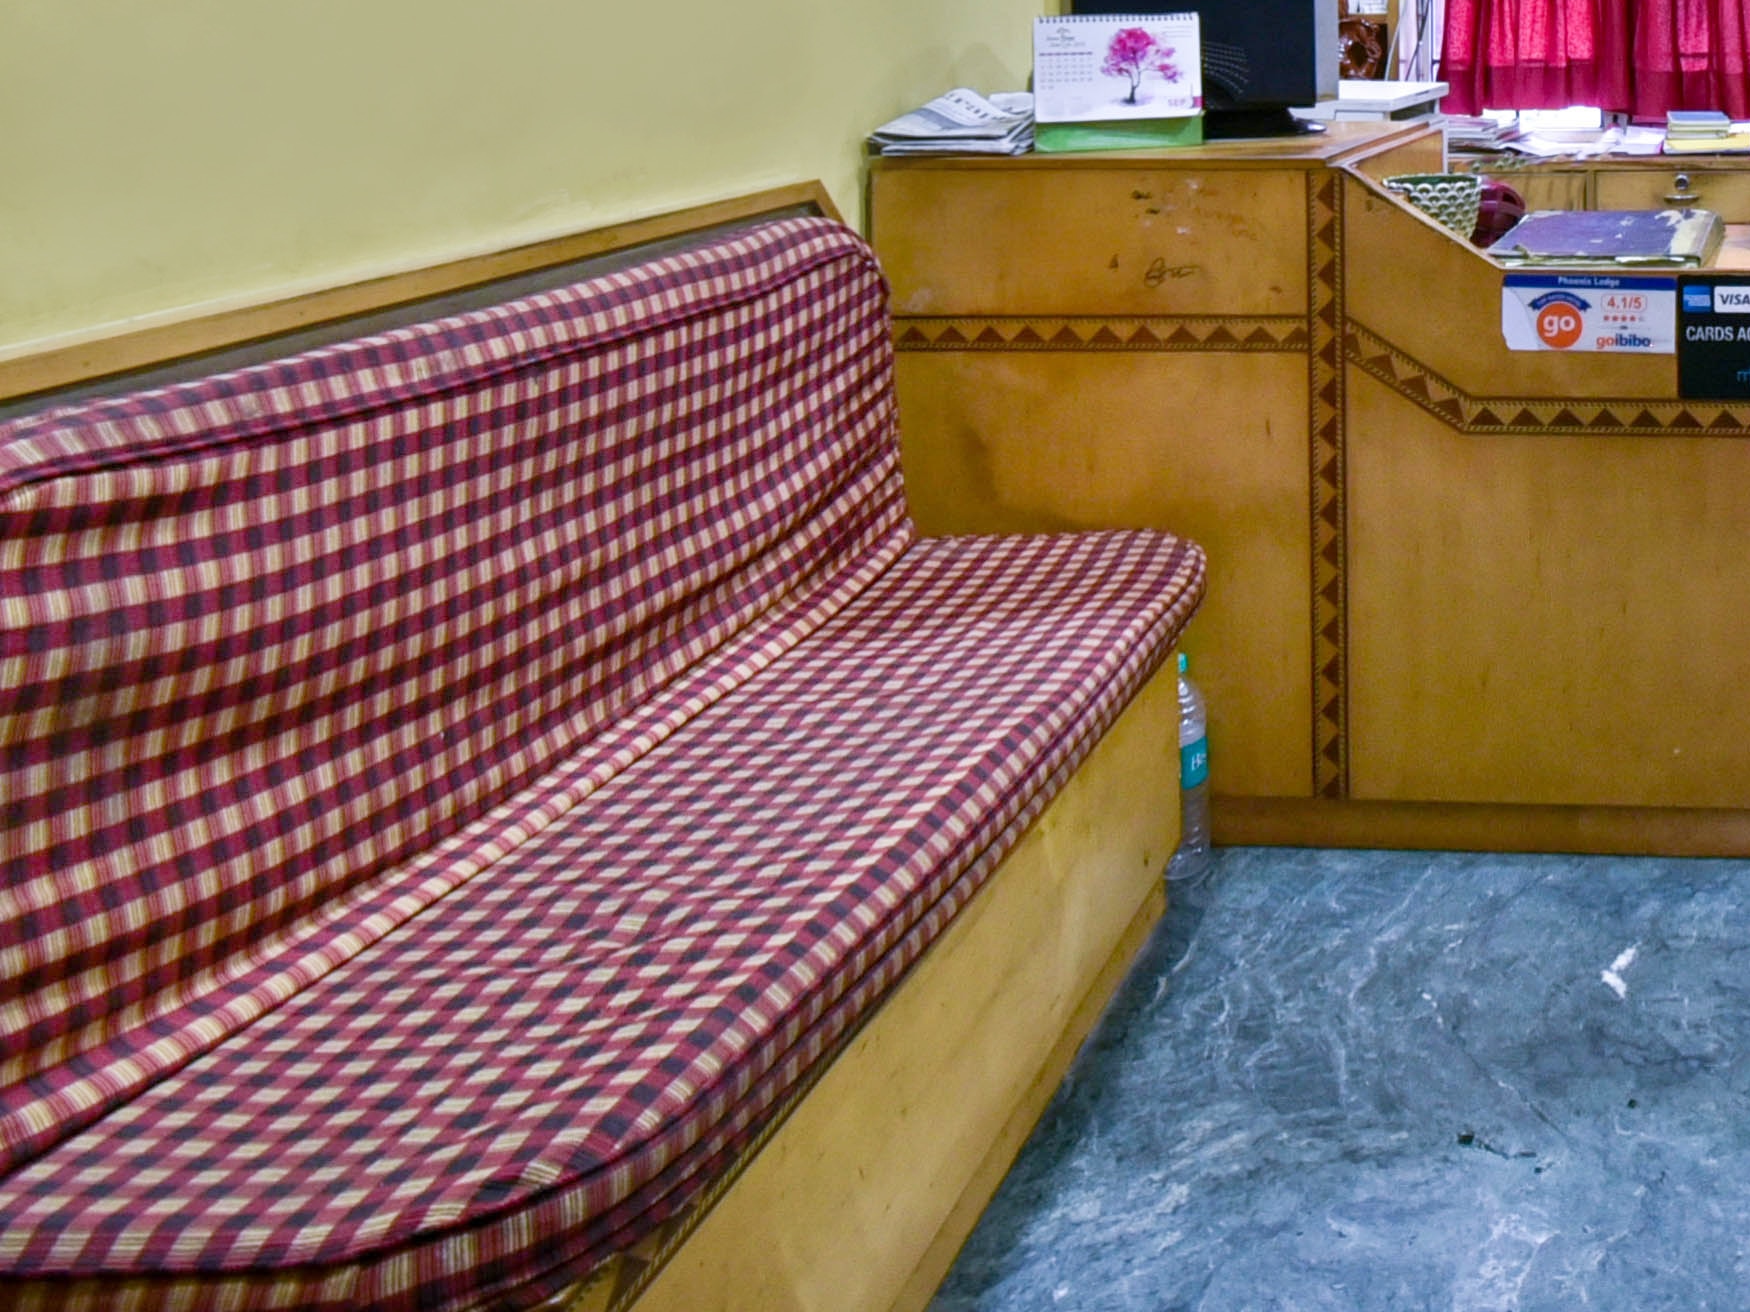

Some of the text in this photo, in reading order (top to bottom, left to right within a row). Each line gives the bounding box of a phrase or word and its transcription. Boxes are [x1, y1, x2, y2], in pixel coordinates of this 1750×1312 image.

[1558, 276, 1621, 288] Phoenix Lodge
[1606, 295, 1643, 310] 4.1/5
[1720, 293, 1750, 306] VISA
[1542, 314, 1576, 337] go
[1685, 325, 1734, 342] CARDS
[1596, 333, 1652, 350] goibibo
